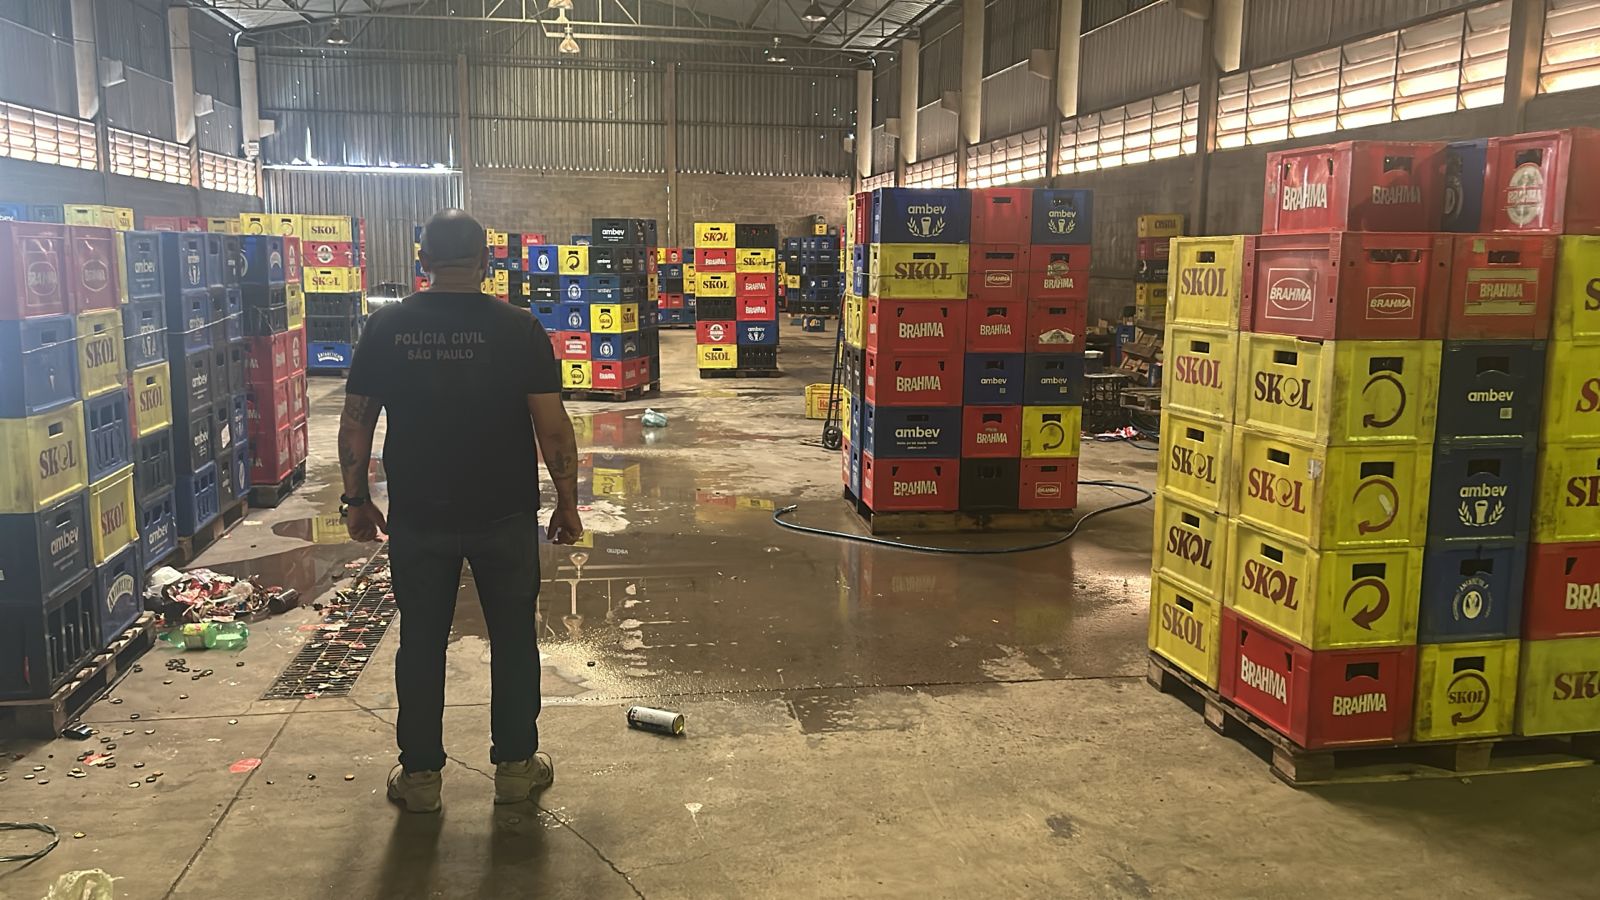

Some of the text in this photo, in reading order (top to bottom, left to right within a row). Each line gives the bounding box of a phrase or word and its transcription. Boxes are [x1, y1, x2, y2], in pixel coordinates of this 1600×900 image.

[1282, 183, 1328, 210] BRAHMA
[1372, 186, 1421, 205] BRAHMA
[908, 204, 946, 214] ambev
[1048, 209, 1076, 218] ambev
[311, 226, 338, 235] SKOL
[703, 232, 728, 241] SKOL
[744, 258, 768, 266] SKOL
[894, 262, 952, 280] SKOL
[312, 276, 340, 286] SKOL
[702, 280, 729, 289] SKOL
[745, 282, 766, 290] BRAHMA
[1044, 278, 1074, 288] BRAHMA
[1181, 268, 1228, 297] SKOL
[1270, 288, 1312, 302] BRAHMA
[1480, 282, 1522, 298] BRAHMA
[1370, 298, 1412, 308] BRAHMA
[394, 331, 486, 344] POLÍCIA CIVIL
[899, 321, 944, 338] BRAHMA
[980, 324, 1012, 336] BRAHMA
[86, 338, 116, 368] SKOL
[408, 348, 474, 360] SÃO PAULO
[704, 352, 730, 360] SKOL
[192, 373, 208, 388] ambev
[980, 376, 1008, 384] ambev
[1176, 356, 1222, 389] SKOL
[896, 376, 942, 392] BRAHMA
[1254, 371, 1313, 411] SKOL
[140, 386, 163, 412] SKOL
[1468, 388, 1514, 402] ambev
[895, 426, 940, 438] ambev
[976, 433, 1008, 444] BRAHMA
[40, 440, 76, 479] SKOL
[1172, 445, 1216, 484] SKOL
[893, 480, 938, 496] BRAHMA
[1248, 468, 1306, 514] SKOL
[1460, 483, 1508, 498] ambev
[101, 502, 127, 536] SKOL
[50, 526, 79, 556] ambev
[148, 522, 168, 545] ambev
[1167, 526, 1212, 570] SKOL
[1242, 559, 1298, 610] SKOL
[1565, 582, 1600, 610] BRA
[1162, 602, 1206, 652] SKOL
[1241, 654, 1287, 704] BRAHMA
[1553, 671, 1600, 700] SK
[1332, 692, 1387, 716] BRAHMA
[1448, 690, 1485, 704] SKOL
